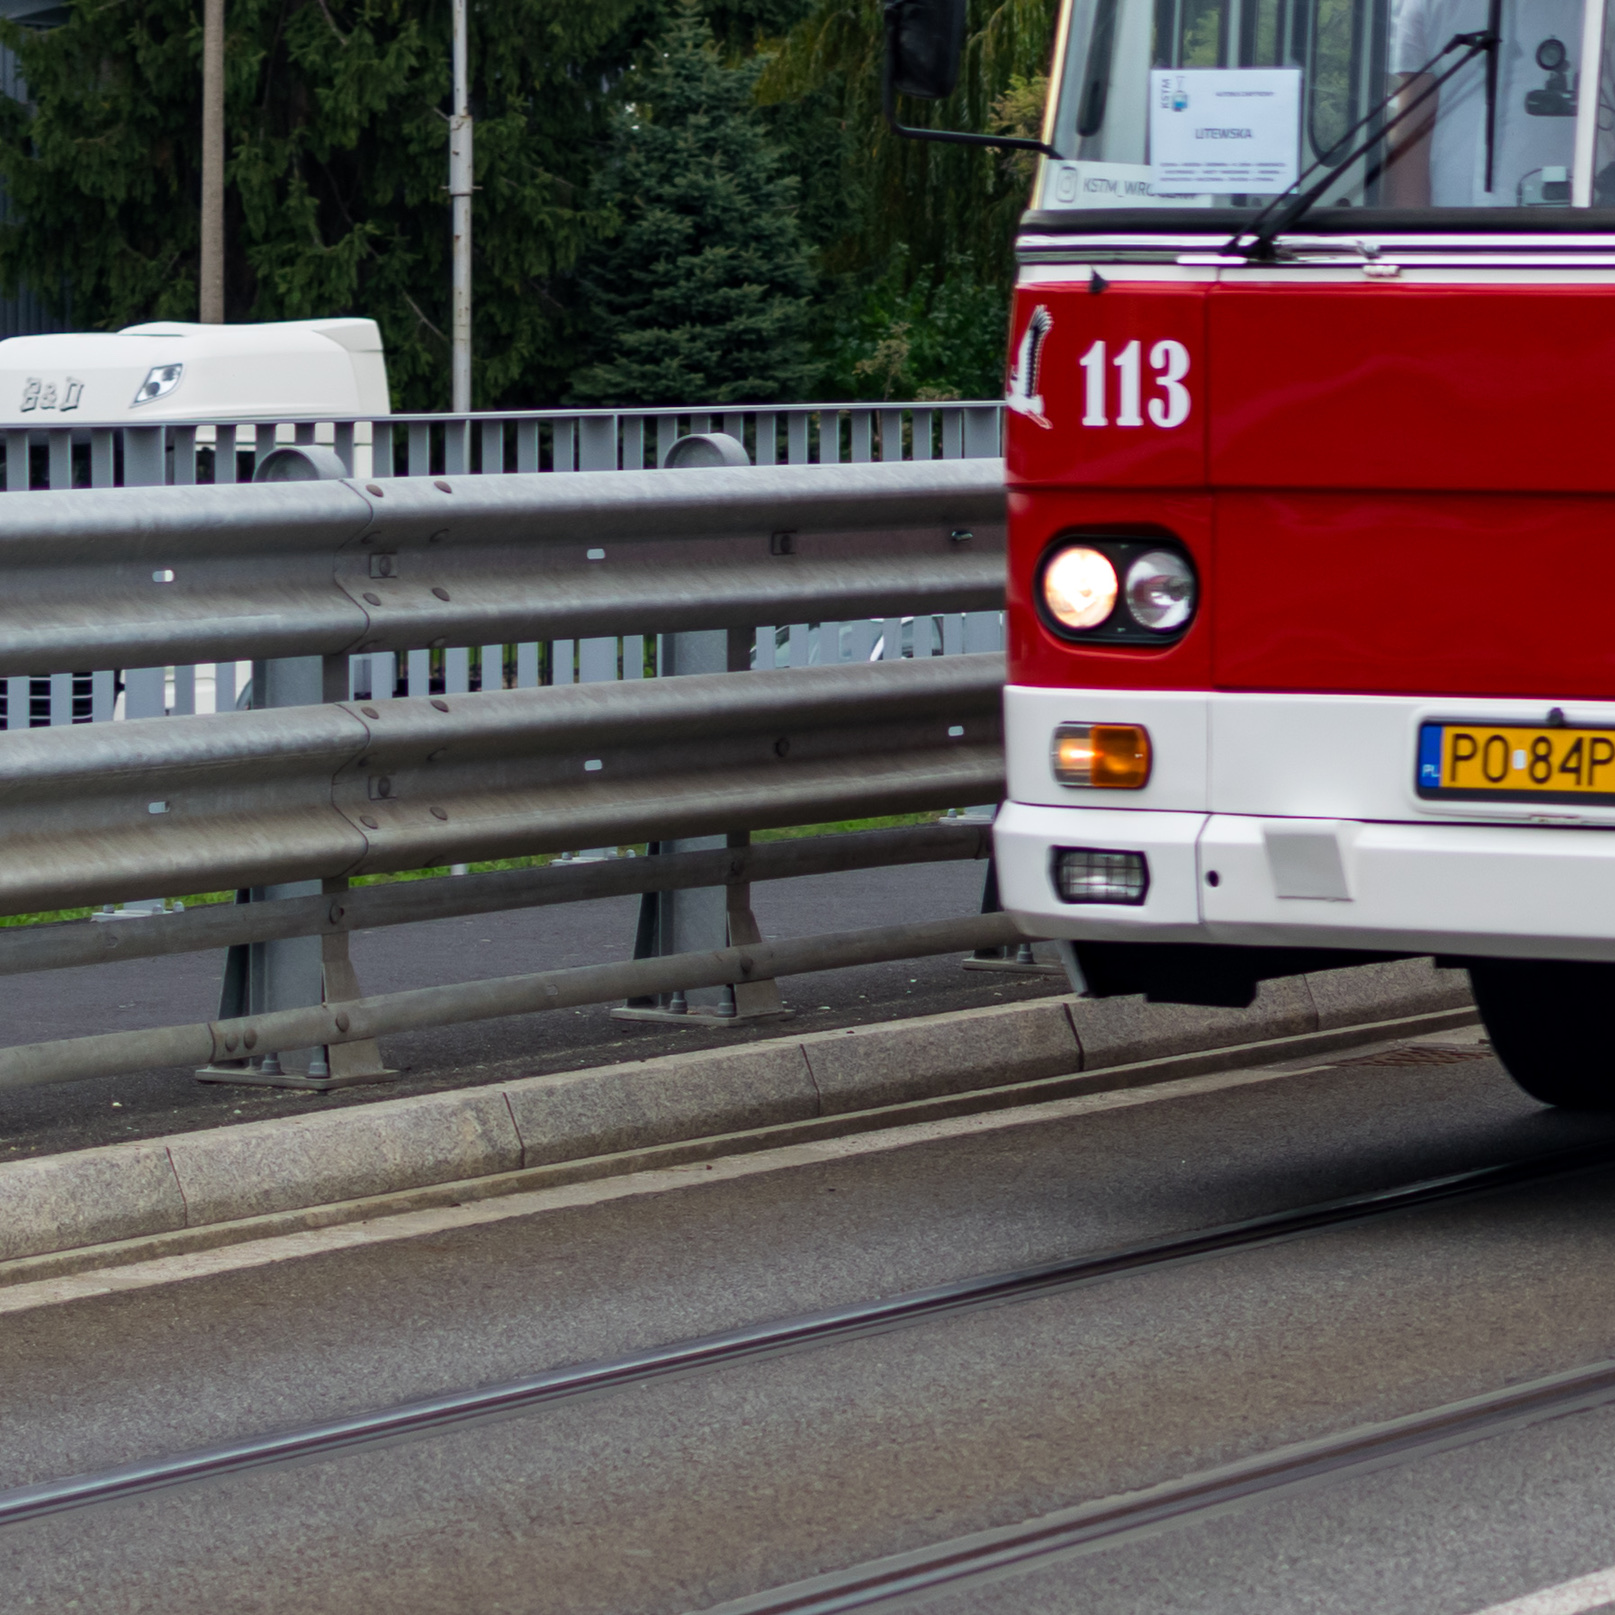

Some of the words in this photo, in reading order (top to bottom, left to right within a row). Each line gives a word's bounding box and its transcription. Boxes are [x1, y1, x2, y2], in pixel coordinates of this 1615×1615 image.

[1194, 128, 1253, 140] LITEWSKA
[1078, 339, 1191, 428] 113
[1450, 733, 1511, 783] PO
[1528, 735, 1615, 786] 84P
